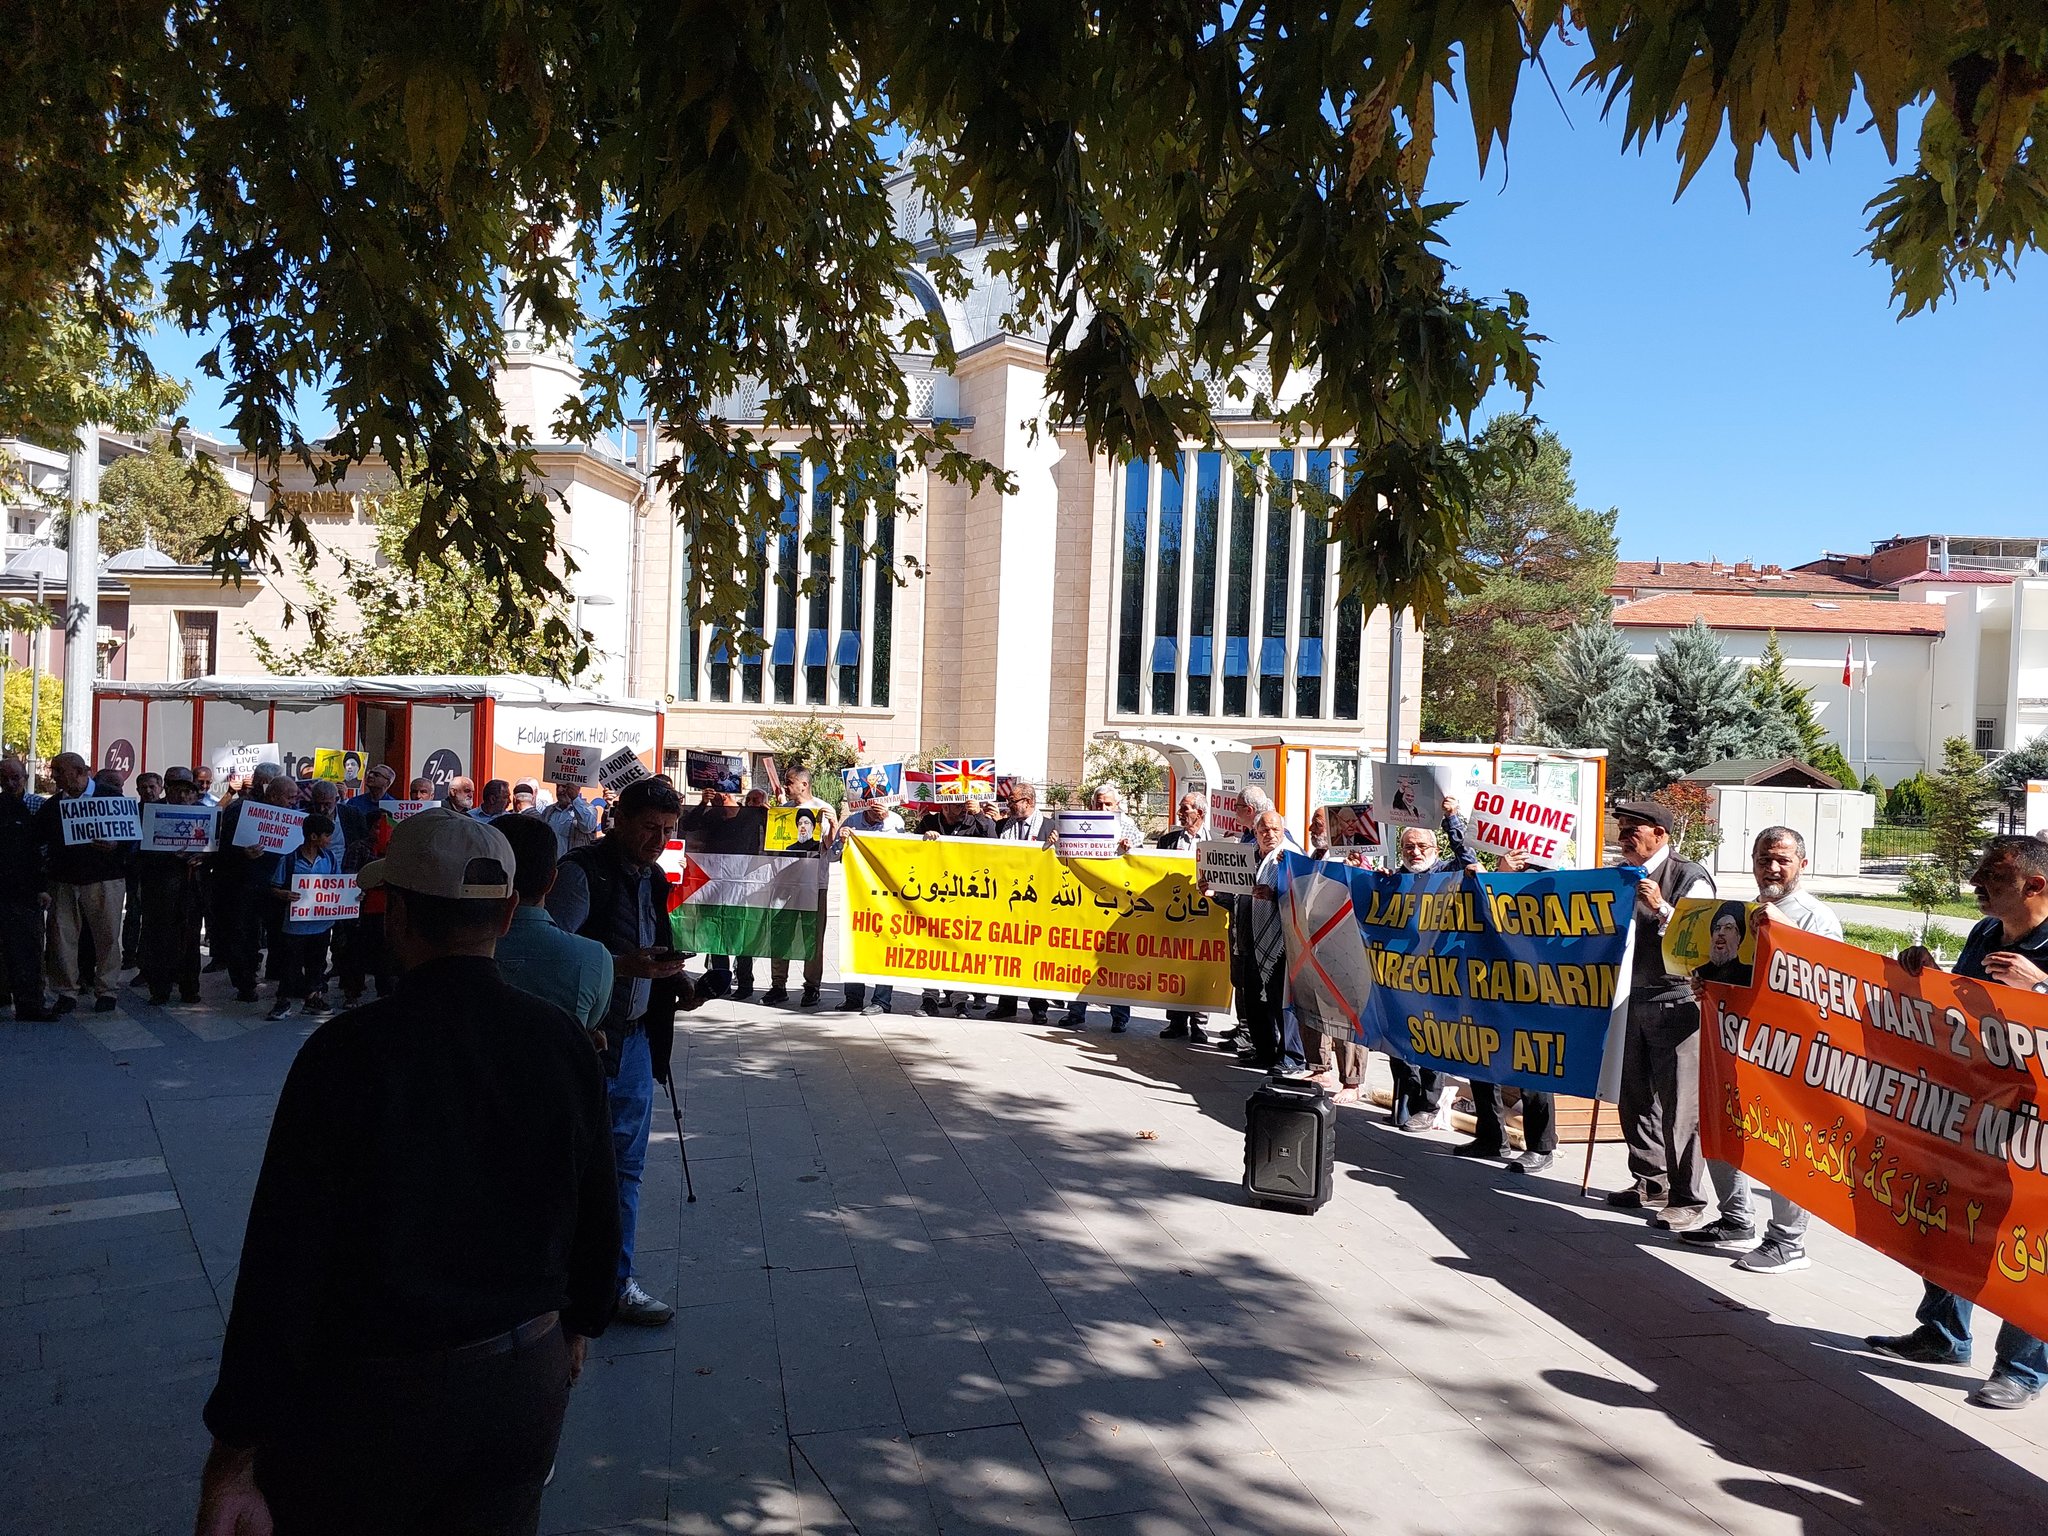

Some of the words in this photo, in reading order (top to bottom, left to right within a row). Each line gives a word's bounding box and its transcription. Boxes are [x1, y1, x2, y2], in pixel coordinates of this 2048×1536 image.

[517, 726, 549, 748] Kolay
[611, 729, 640, 746] Sonuç
[110, 743, 130, 771] 7/24
[232, 747, 260, 756] LONG
[236, 756, 258, 765] LIVE
[562, 748, 581, 757] SAVE
[687, 752, 725, 765] KAHROLSUN
[726, 758, 741, 766] ABD
[216, 765, 236, 774] THE
[429, 754, 455, 785] 7/24
[555, 756, 586, 766] AL-AQSA
[560, 765, 578, 774] FREE
[608, 749, 638, 775] HOME
[551, 772, 587, 784] PALESTINE
[604, 765, 645, 792] YANKEE
[398, 802, 423, 810] STOP
[954, 794, 969, 802] WITH
[970, 793, 995, 801] ENGLAND
[1211, 794, 1221, 809] GO
[61, 800, 138, 819] KAHROLSUN
[247, 806, 280, 822] HAMAS'A
[1474, 791, 1504, 815] GO
[1509, 799, 1576, 834] HOME
[70, 818, 136, 841] İNGİLTERE
[257, 820, 290, 837] DİRENİŞE
[258, 835, 284, 849] DEVAM
[1476, 820, 1558, 859] YANKEE
[1206, 849, 1248, 867] KÜRECİK
[313, 878, 345, 890] AQSA
[1201, 869, 1256, 887] KAPATILSIN
[315, 892, 341, 904] Only
[291, 906, 310, 917] For
[313, 905, 359, 916] Muslims
[1365, 890, 1416, 929] LAF
[1418, 884, 1484, 932] DEĞİL
[1486, 884, 1617, 937] İCRAAT
[852, 908, 884, 938] HİÇ
[890, 910, 982, 941] ŞÜPHESİZ
[988, 920, 1042, 946] GALİP
[1049, 926, 1131, 955] GELECEK
[1136, 934, 1226, 962] OLANLAR
[885, 943, 1022, 978] HİZBULLAH'TIR
[1033, 961, 1092, 987] (Maide
[1097, 966, 1152, 991] Suresi
[1157, 973, 1186, 995] 56)
[1367, 941, 1462, 997] ÜRECİK
[1768, 948, 1862, 1021] GERÇEK
[1863, 981, 1936, 1048] VAAT
[1945, 1008, 1972, 1059] 2
[1407, 1010, 1501, 1067] SÖKÜP
[1513, 1030, 1566, 1077] AT!
[1717, 1000, 1800, 1078] İSLAM
[1804, 1032, 1972, 1143] ÜMMETİNE
